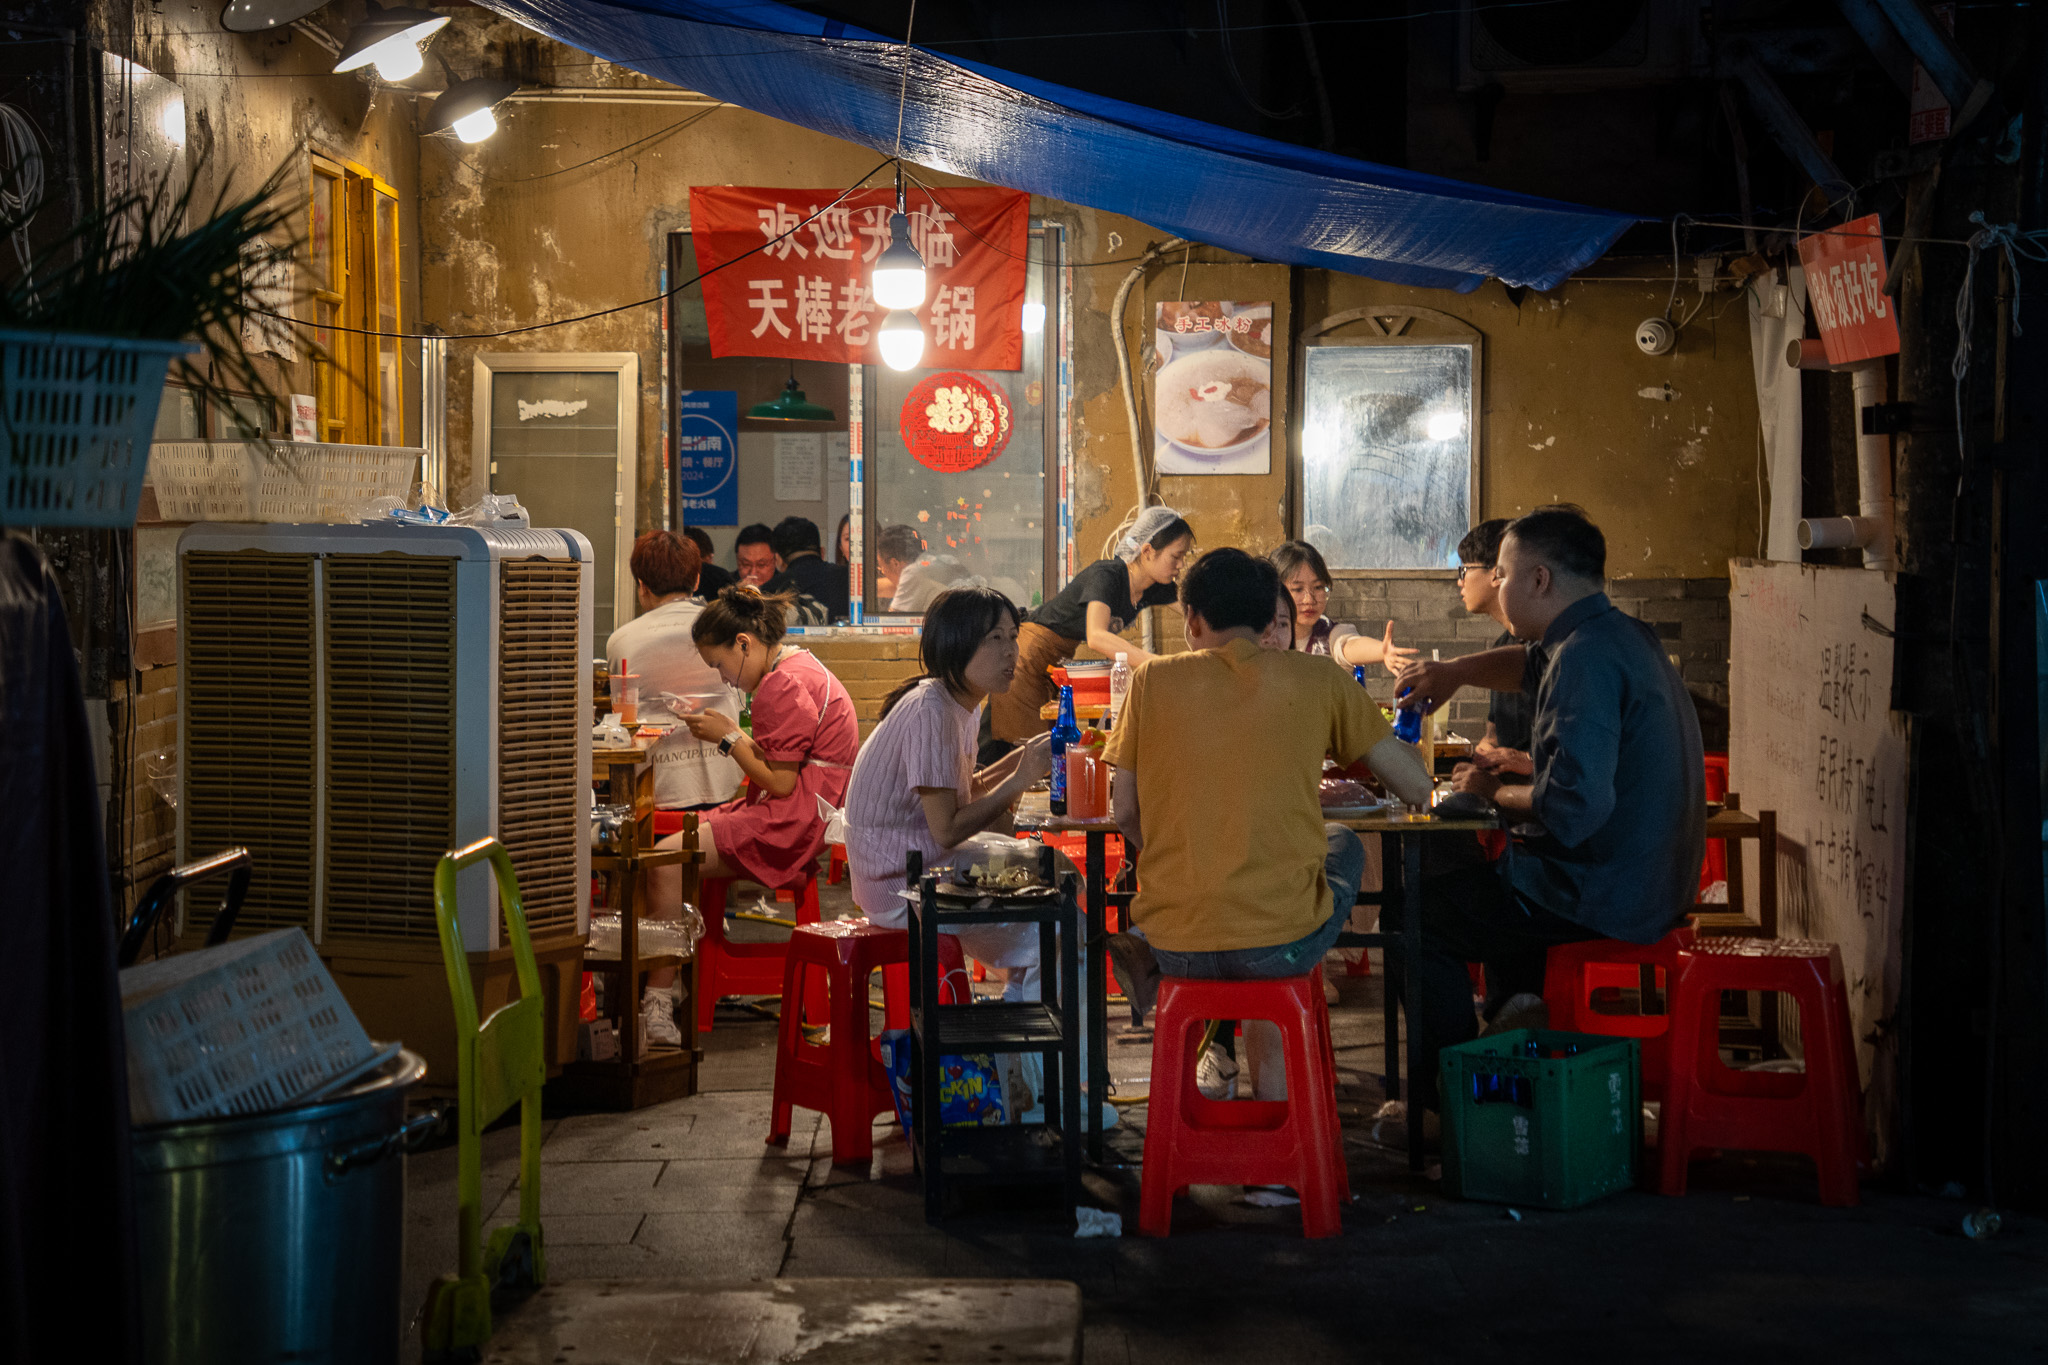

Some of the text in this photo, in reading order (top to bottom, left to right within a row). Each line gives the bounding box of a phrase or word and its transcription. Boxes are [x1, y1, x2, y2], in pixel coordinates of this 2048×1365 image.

[757, 202, 957, 268] 欢迎光临
[747, 274, 976, 350] 天棒老锅
[1174, 315, 1253, 334] 手工冰粉
[1818, 642, 1872, 723] 温馨提示
[1815, 735, 1888, 834] 居民楼下晚上
[1815, 820, 1888, 933] 十点请勿喧哗
